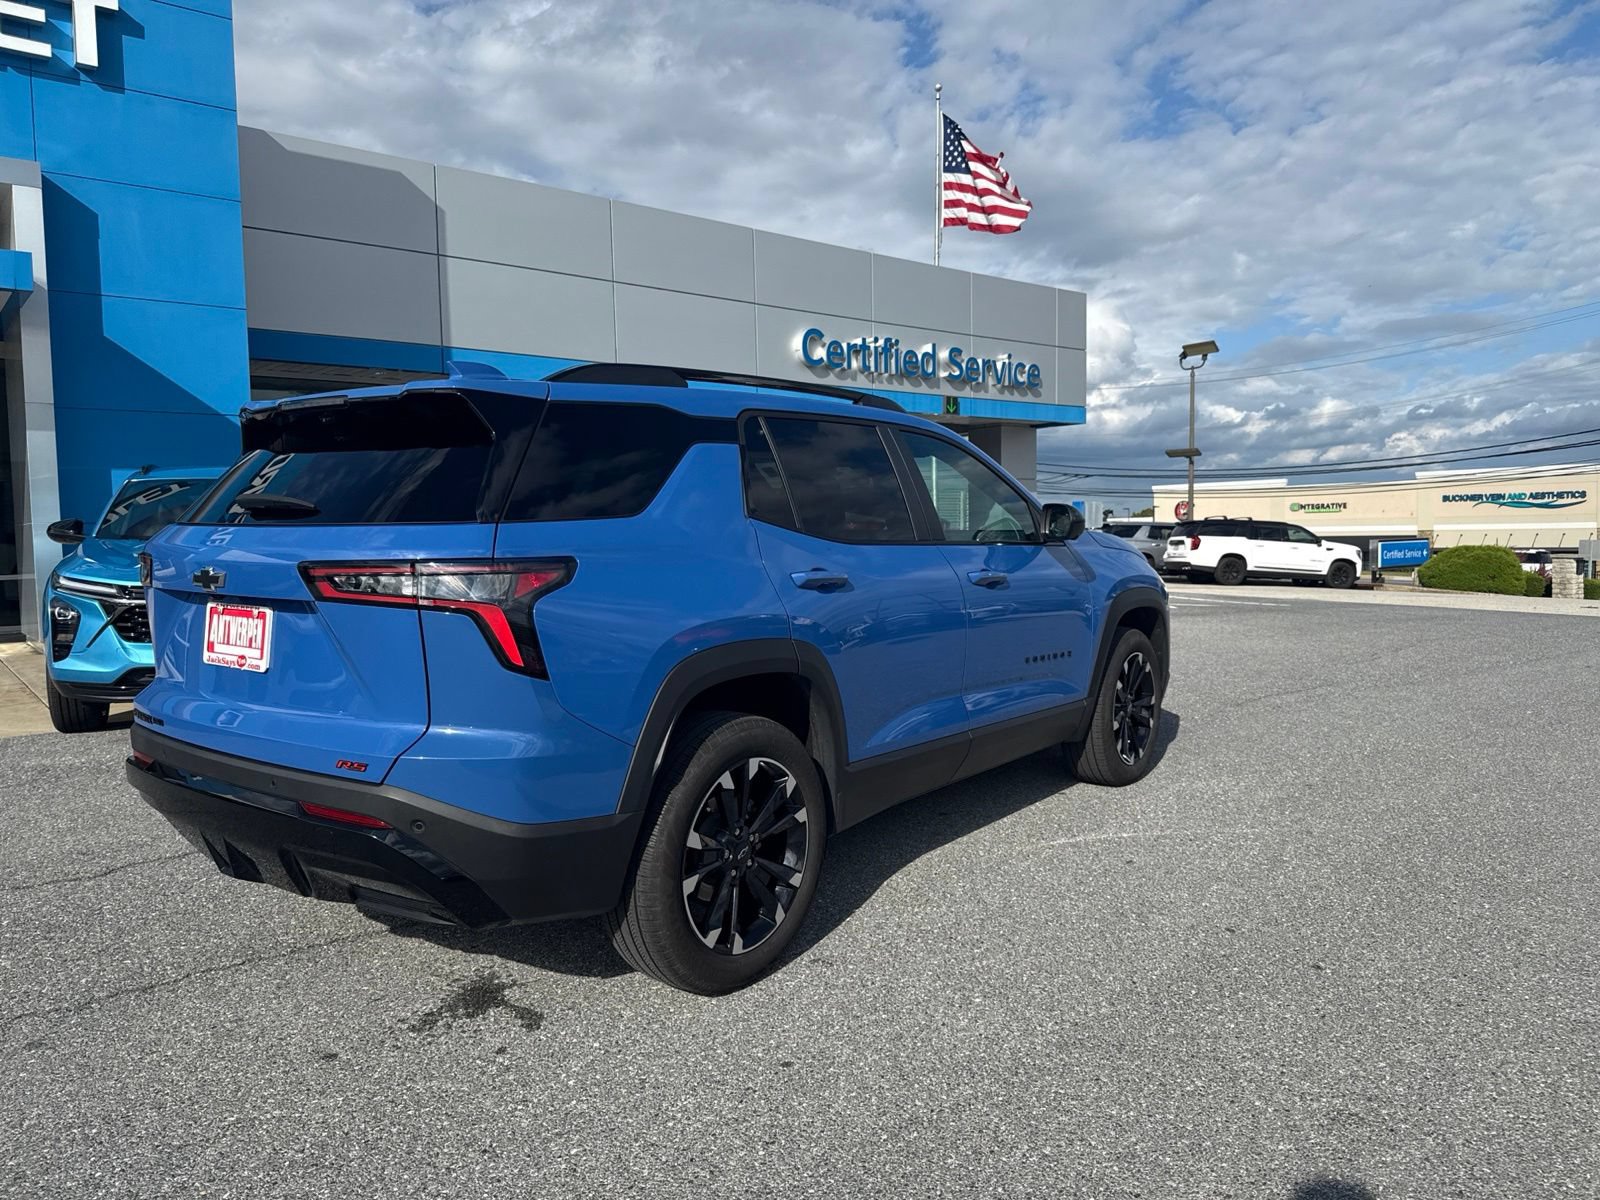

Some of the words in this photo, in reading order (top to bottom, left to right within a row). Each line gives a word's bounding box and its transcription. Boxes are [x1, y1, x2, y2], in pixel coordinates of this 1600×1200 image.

[801, 328, 937, 378] Certified
[945, 346, 1041, 388] Service
[1442, 494, 1484, 502] BUCKNER
[1485, 493, 1506, 501] VEIN
[1507, 492, 1527, 500] AND
[1528, 490, 1587, 500] AESTHETICS
[1383, 550, 1404, 559] Certified
[1405, 549, 1421, 558] Service
[209, 613, 264, 650] ANTWERPEN
[336, 759, 369, 772] RS
